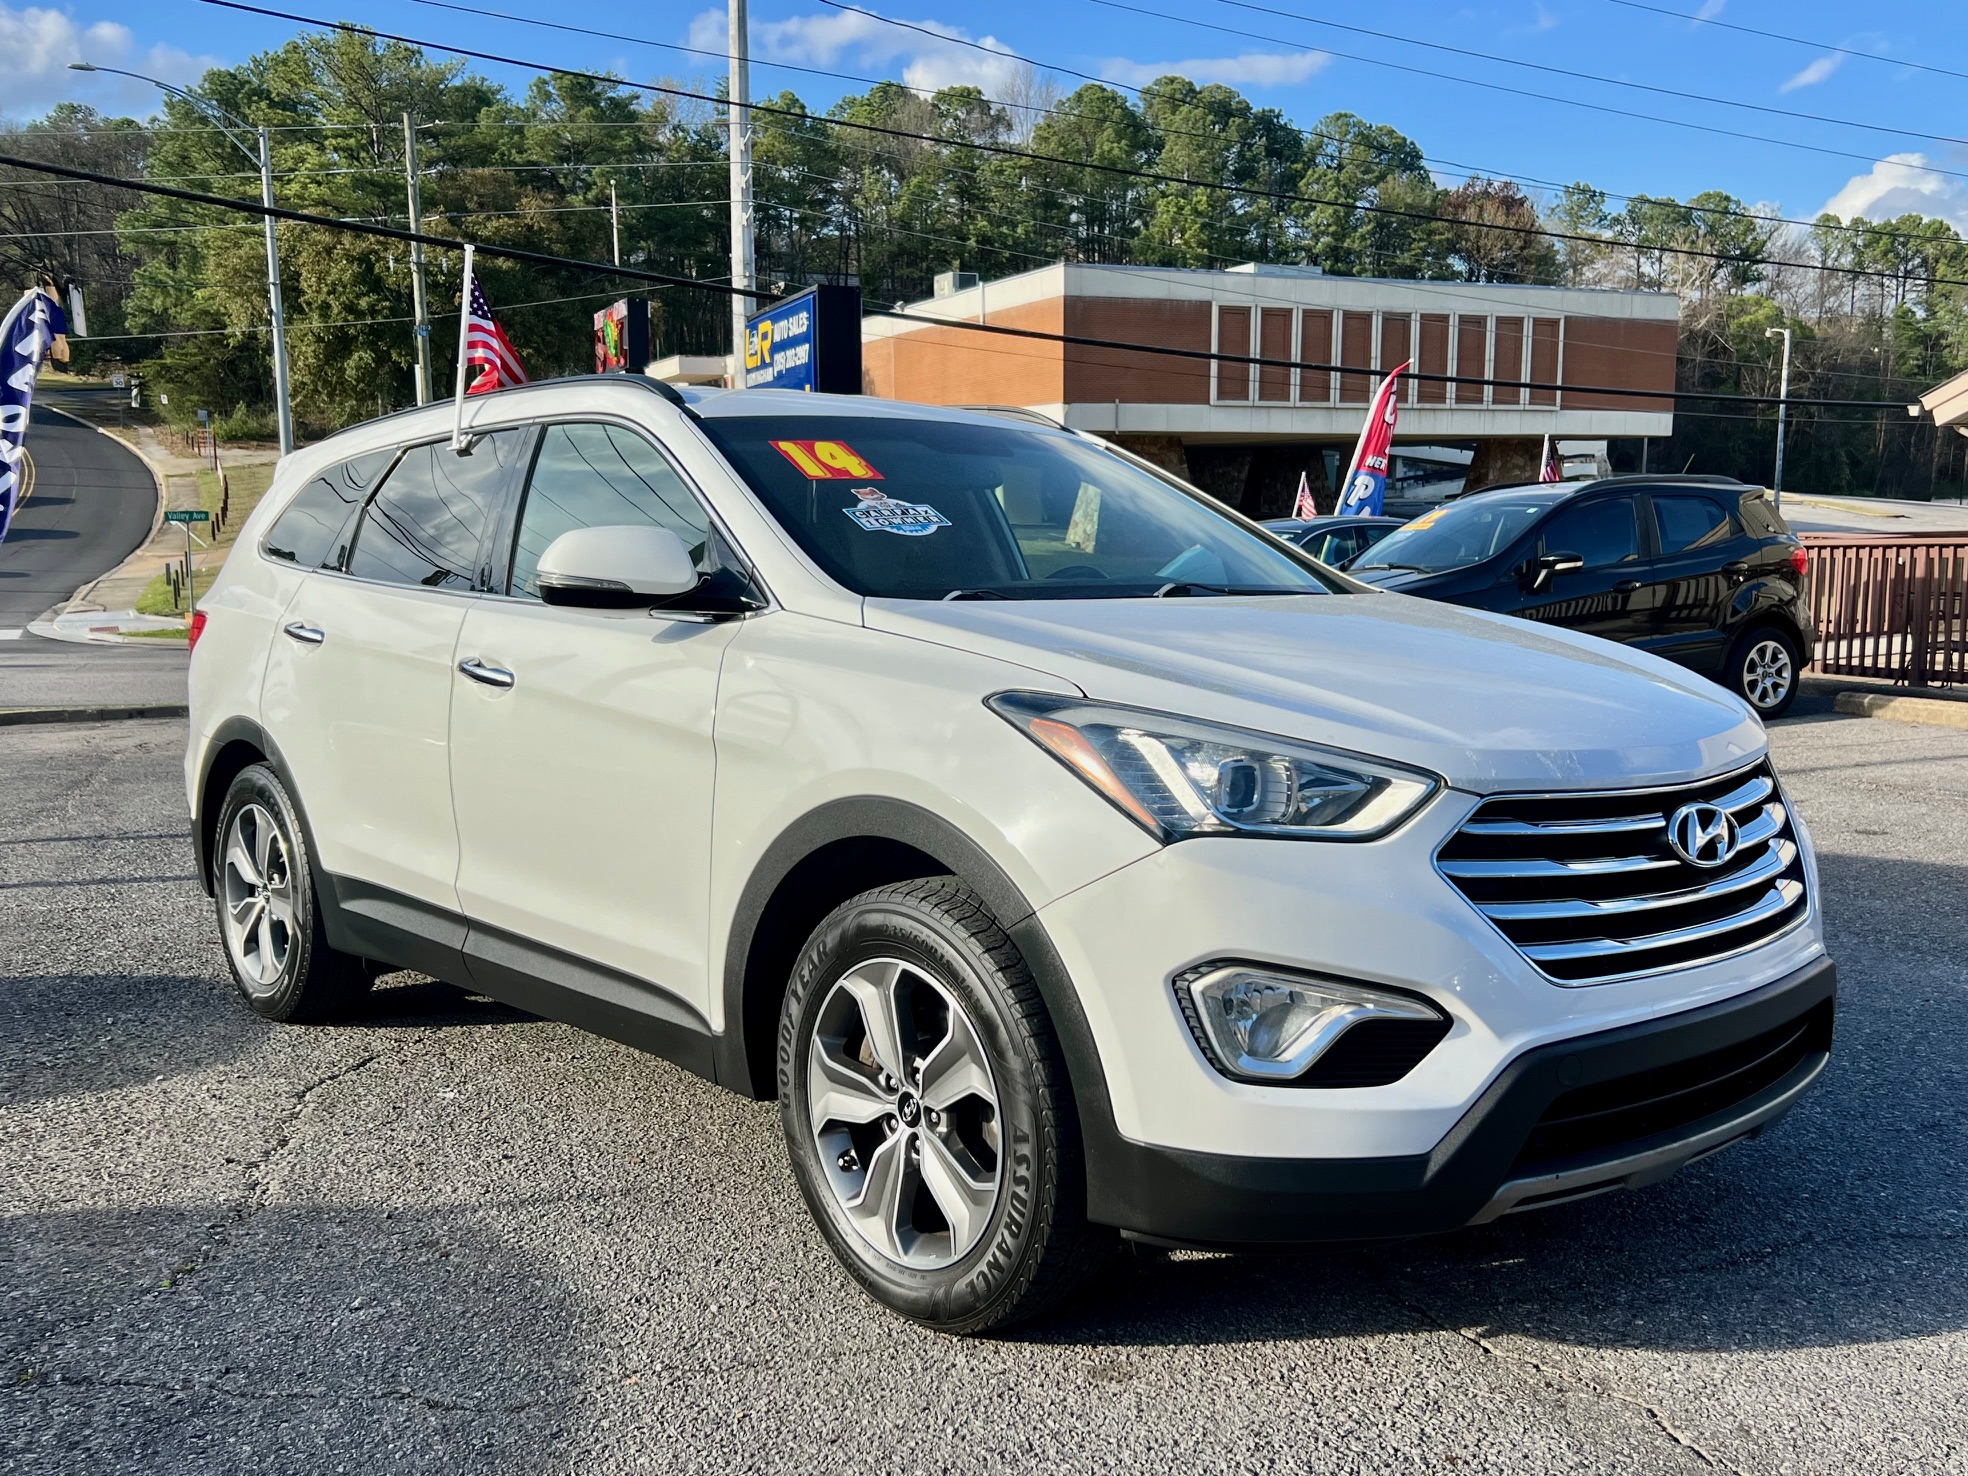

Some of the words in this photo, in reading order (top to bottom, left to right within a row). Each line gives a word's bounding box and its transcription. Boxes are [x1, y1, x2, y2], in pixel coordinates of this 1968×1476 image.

[773, 319, 788, 343] AUTO
[788, 311, 809, 337] SALES
[778, 441, 873, 478] 14
[167, 512, 189, 521] Valley
[192, 512, 206, 520] Ave
[853, 508, 934, 518] CARFAX
[879, 516, 944, 526] OWNER
[965, 1120, 1031, 1300] ASSURANCE
